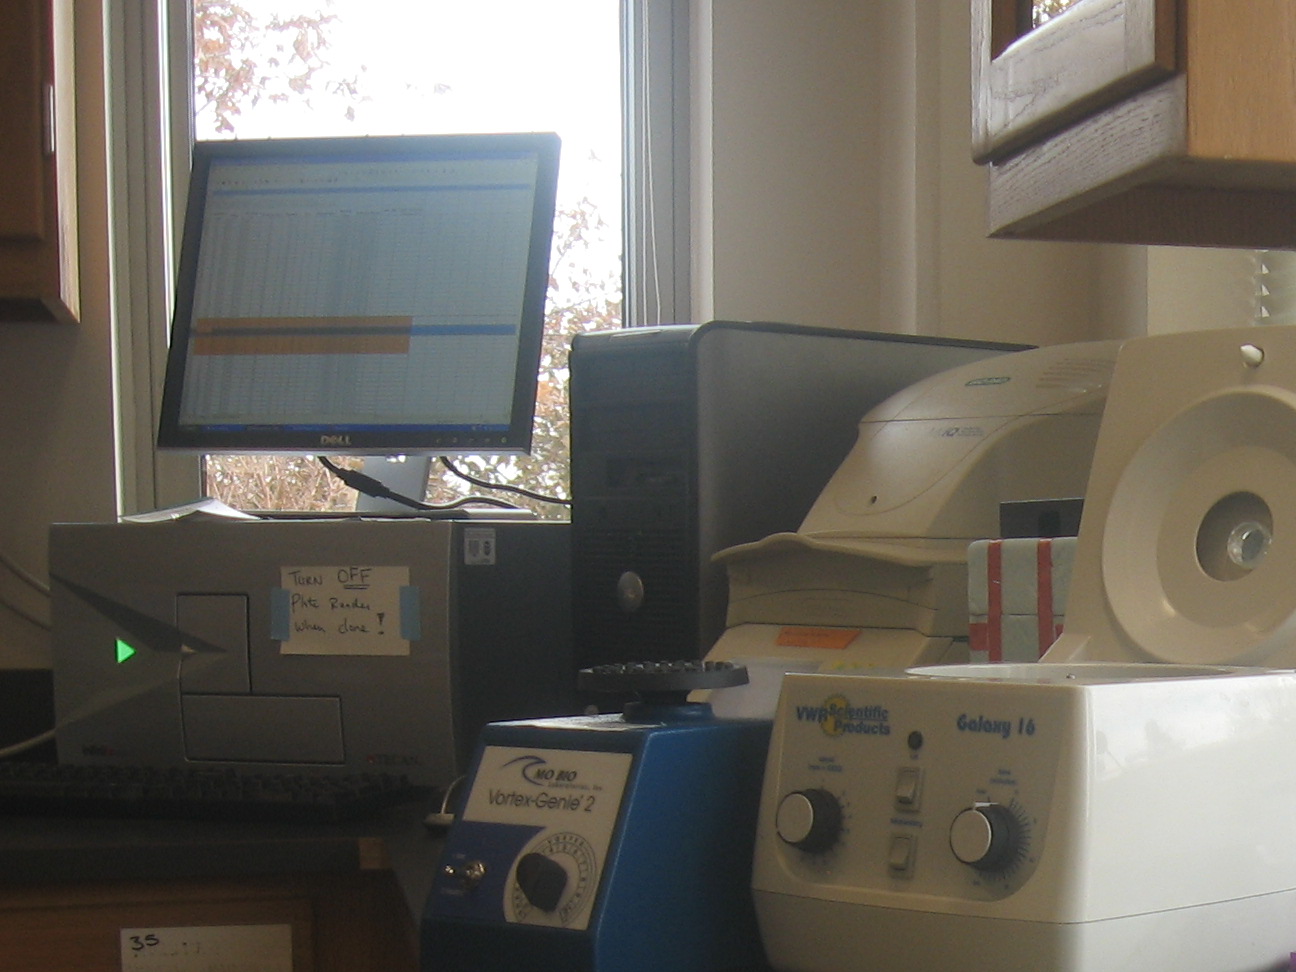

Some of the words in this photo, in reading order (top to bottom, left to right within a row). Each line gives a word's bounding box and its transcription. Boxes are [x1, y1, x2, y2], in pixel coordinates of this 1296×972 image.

[337, 567, 373, 584] OFF
[829, 703, 889, 720] Scientific
[834, 719, 890, 735] Products
[956, 713, 1011, 738] Galaxy
[1018, 717, 1036, 736] 16
[584, 795, 596, 812] 2
